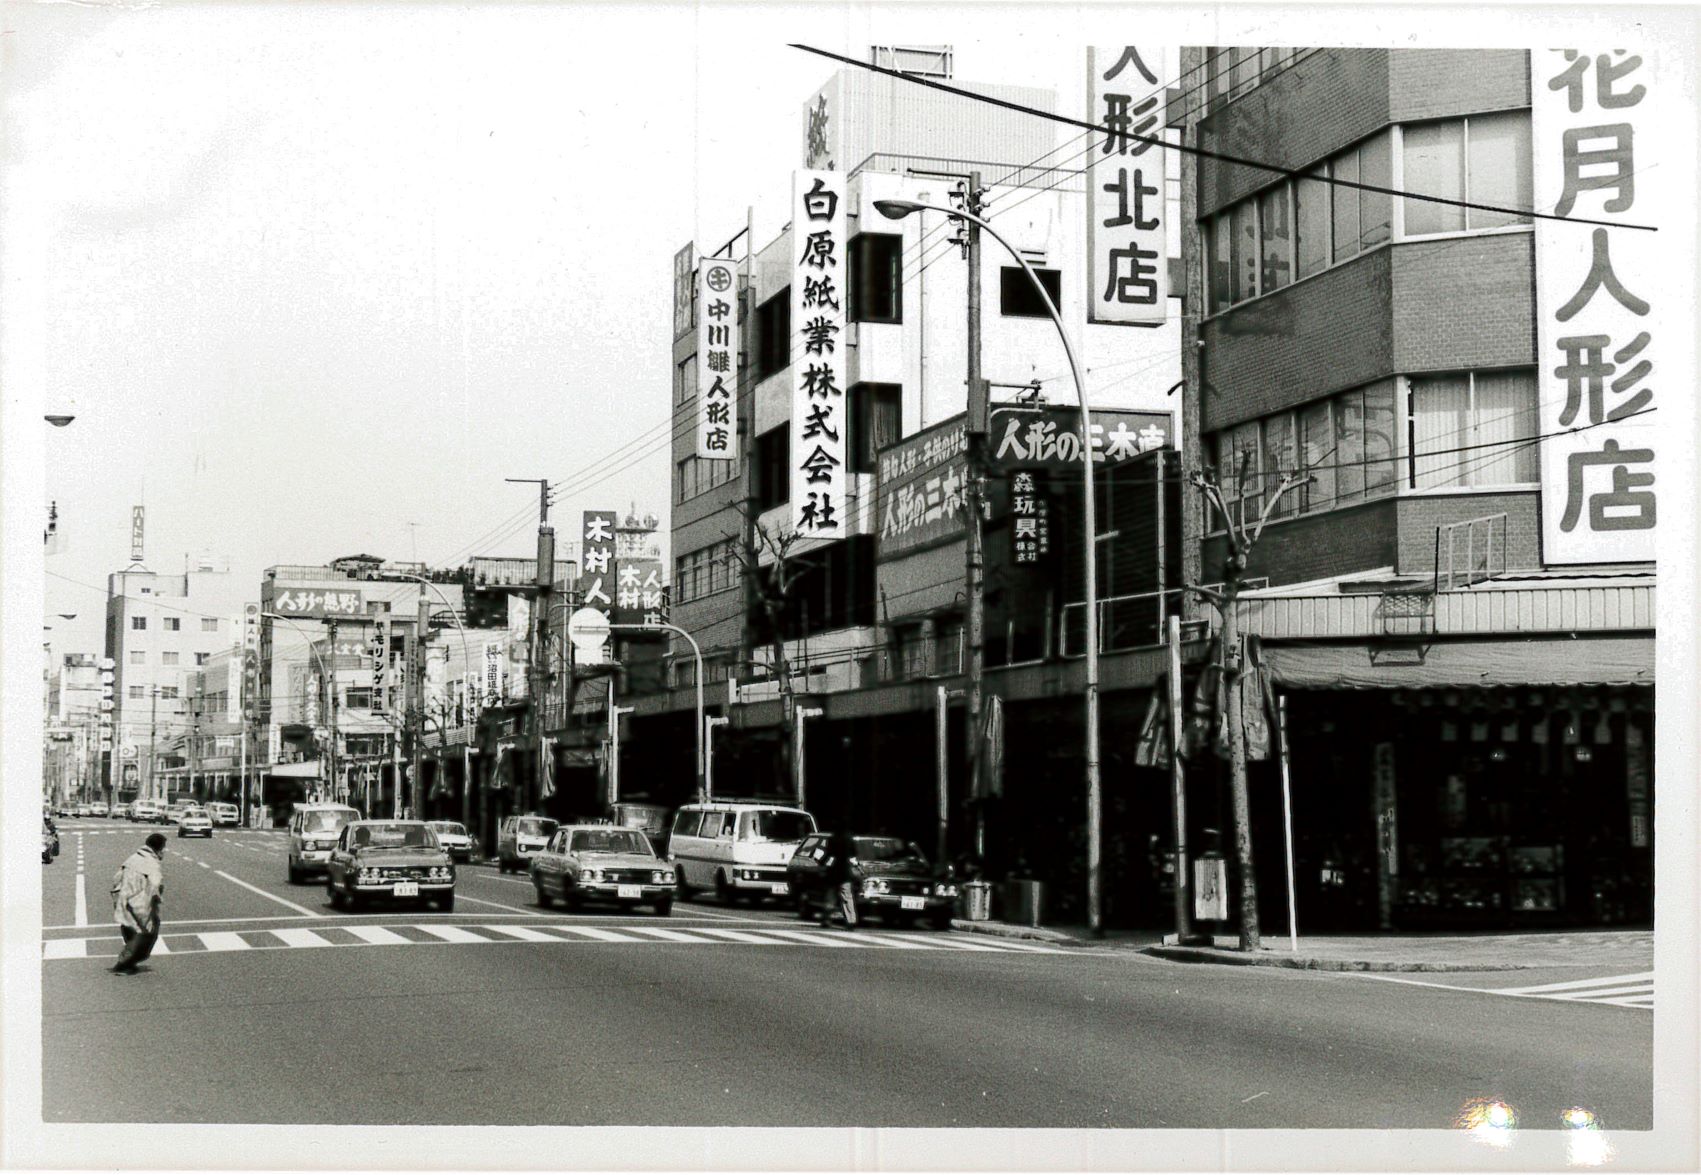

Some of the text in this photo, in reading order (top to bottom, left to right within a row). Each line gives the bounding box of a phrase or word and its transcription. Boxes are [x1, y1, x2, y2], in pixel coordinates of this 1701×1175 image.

[1103, 46, 1160, 305] 人形北店
[706, 298, 731, 451] 中川雛人形店
[797, 178, 842, 532] 白原紙業株式会社
[1547, 48, 1657, 533] 花月人形店
[584, 516, 613, 622] 木村人
[881, 465, 990, 541] 人形の三木
